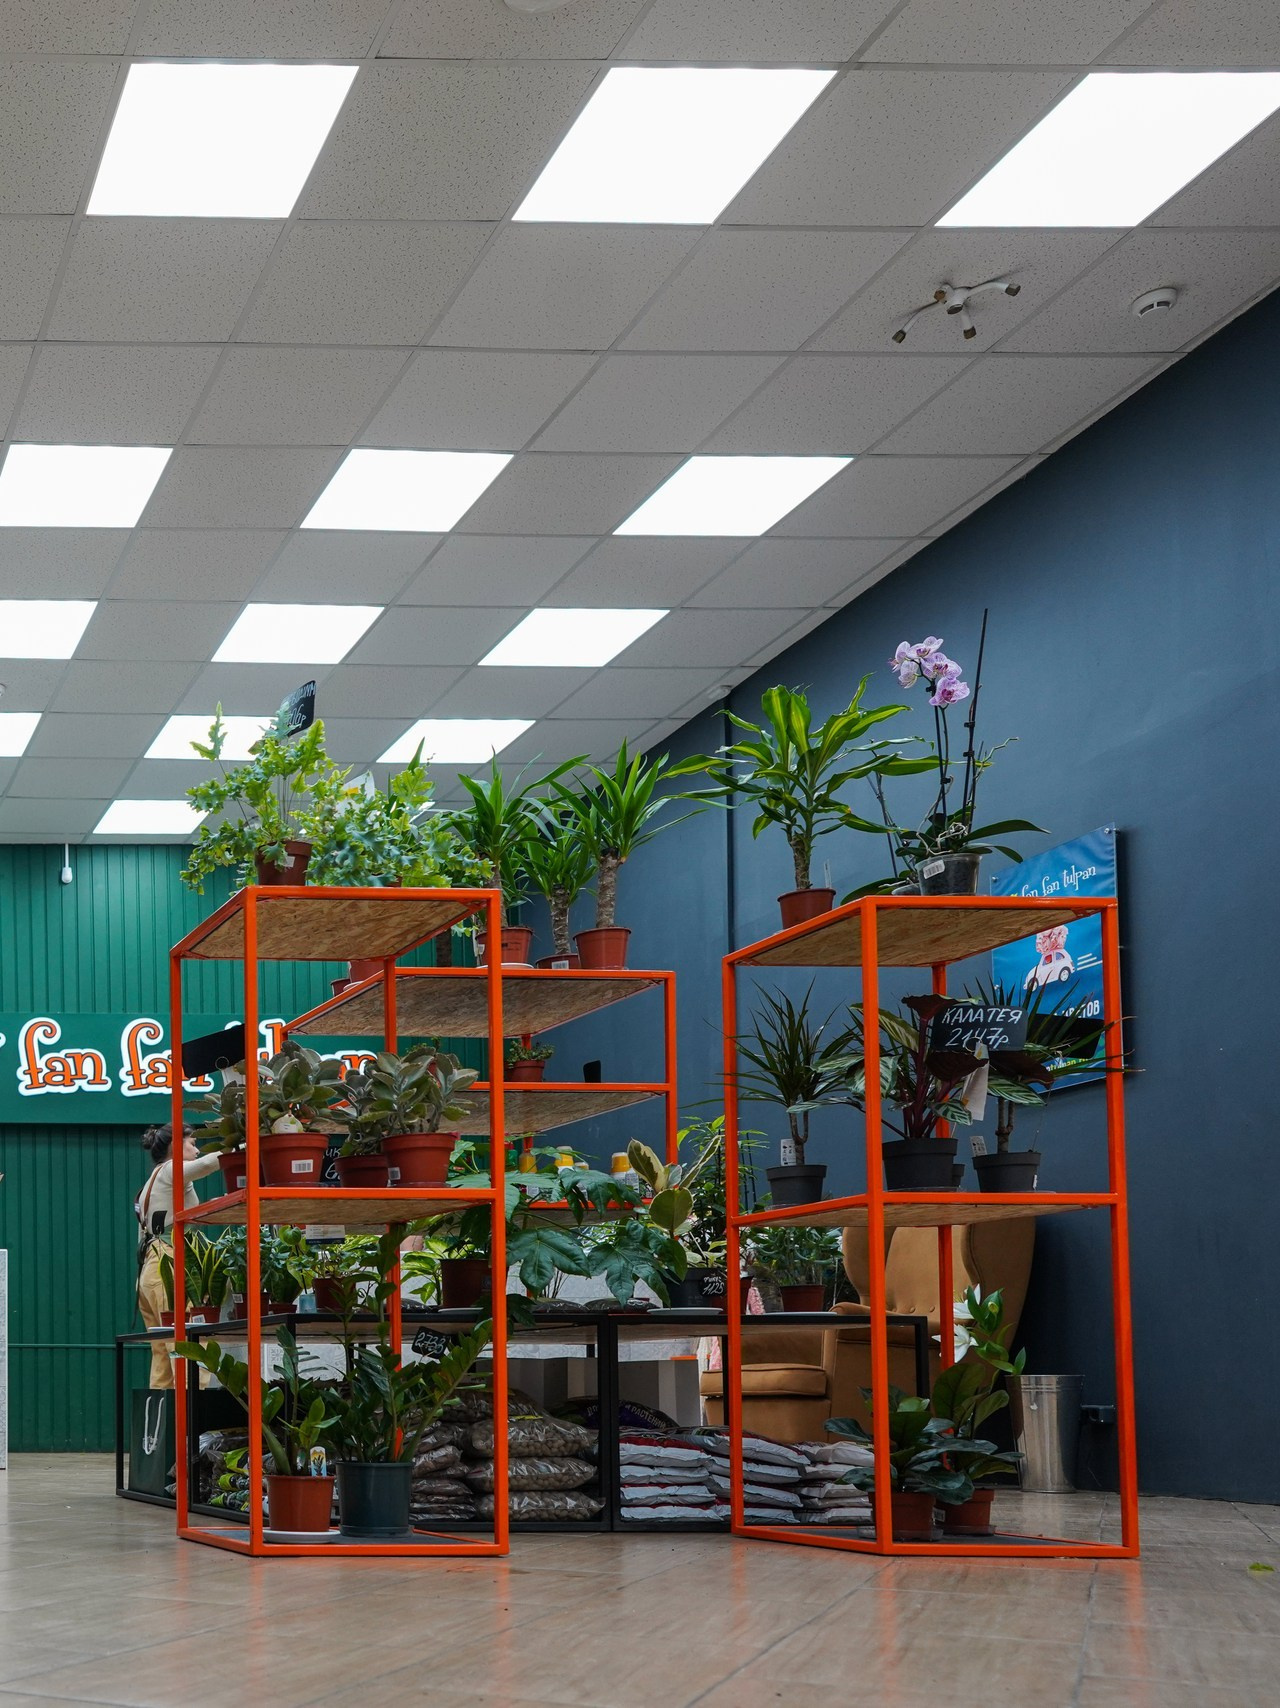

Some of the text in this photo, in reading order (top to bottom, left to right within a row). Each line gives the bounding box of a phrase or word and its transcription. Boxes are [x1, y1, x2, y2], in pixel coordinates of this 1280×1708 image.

[1041, 875, 1060, 897] fan
[1062, 865, 1097, 891] tulpan
[941, 1007, 1023, 1025] КАЛАТЕЯ
[18, 1018, 111, 1095] fan
